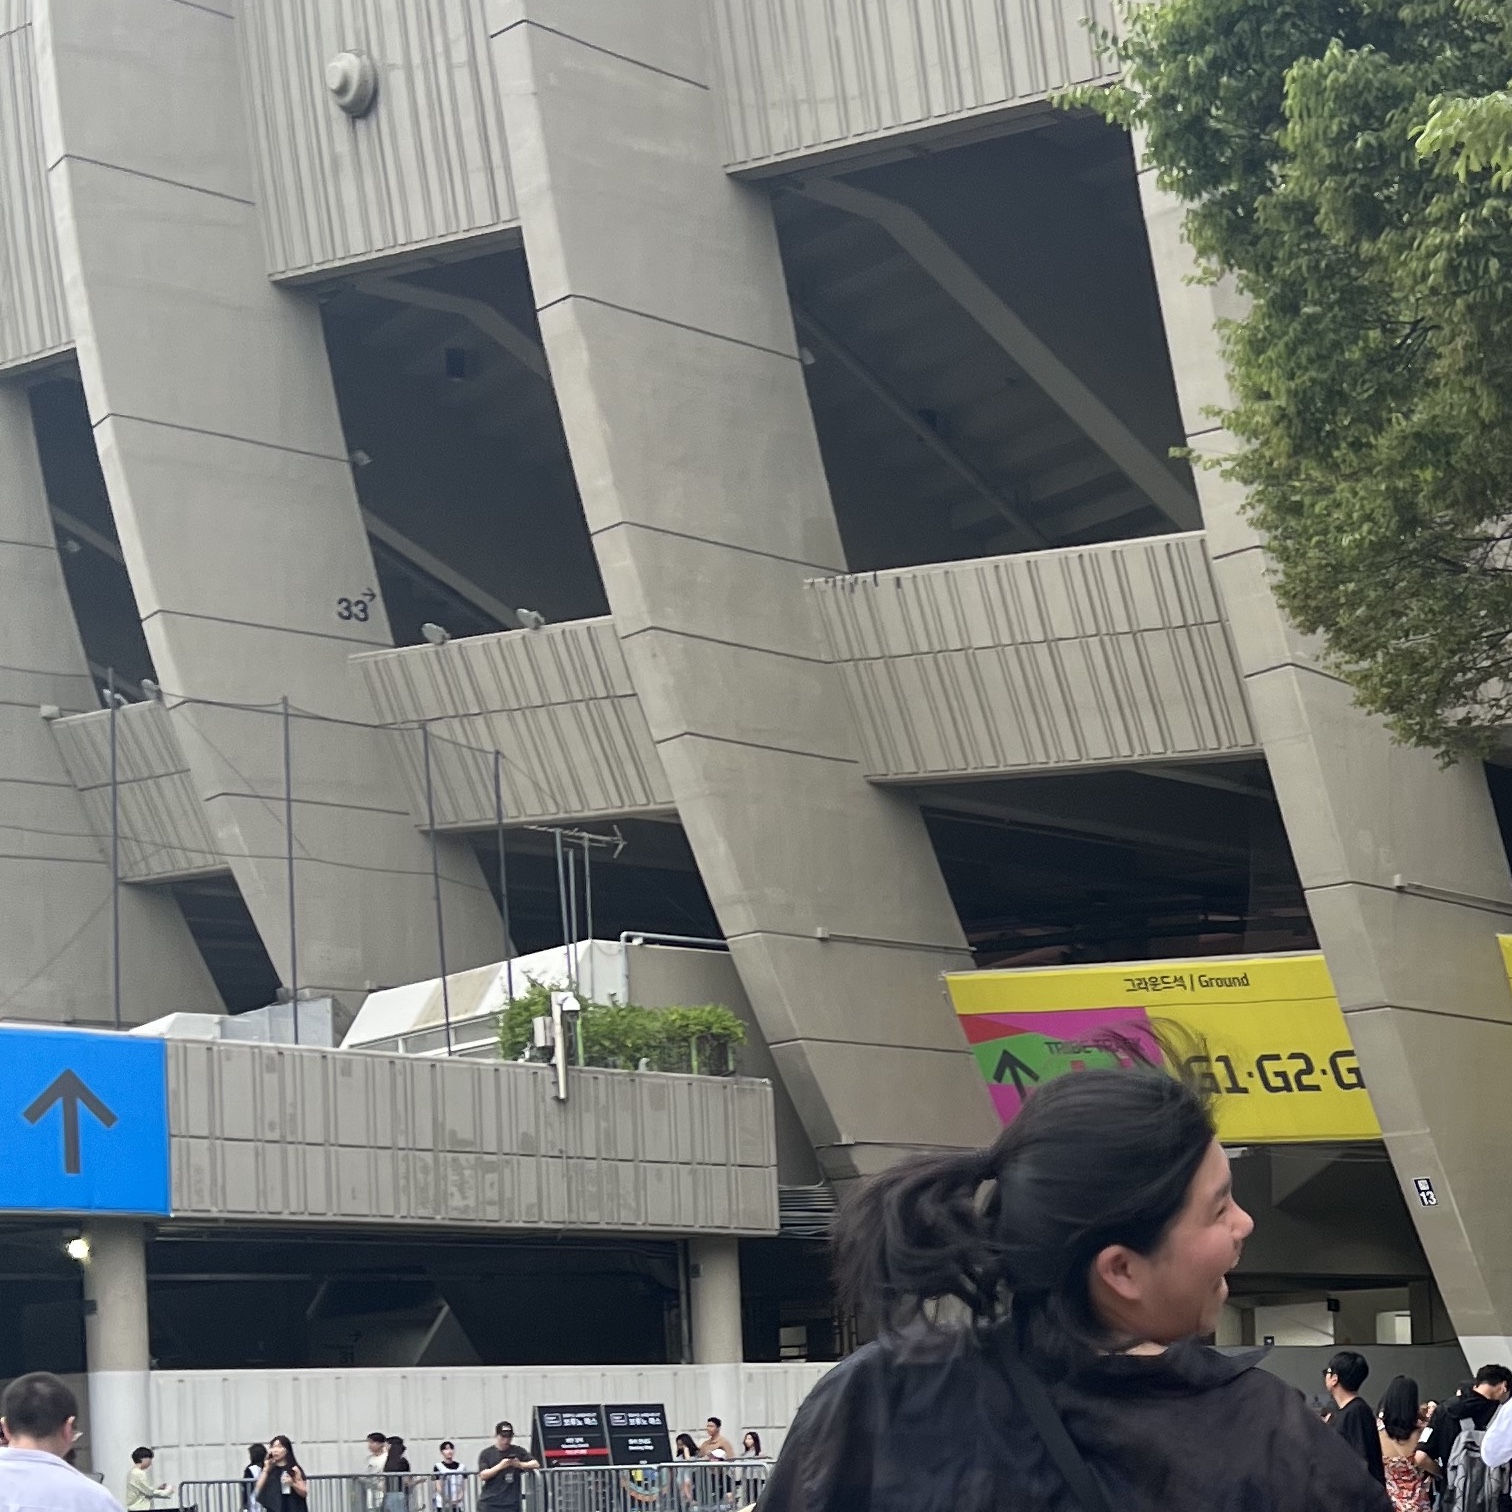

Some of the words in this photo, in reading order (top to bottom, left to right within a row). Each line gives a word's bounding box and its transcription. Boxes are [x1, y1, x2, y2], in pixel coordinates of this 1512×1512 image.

[337, 597, 369, 622] 33
[1123, 975, 1187, 992] 그라운드석
[1198, 972, 1250, 988] Ground
[1420, 1191, 1437, 1206] 13
